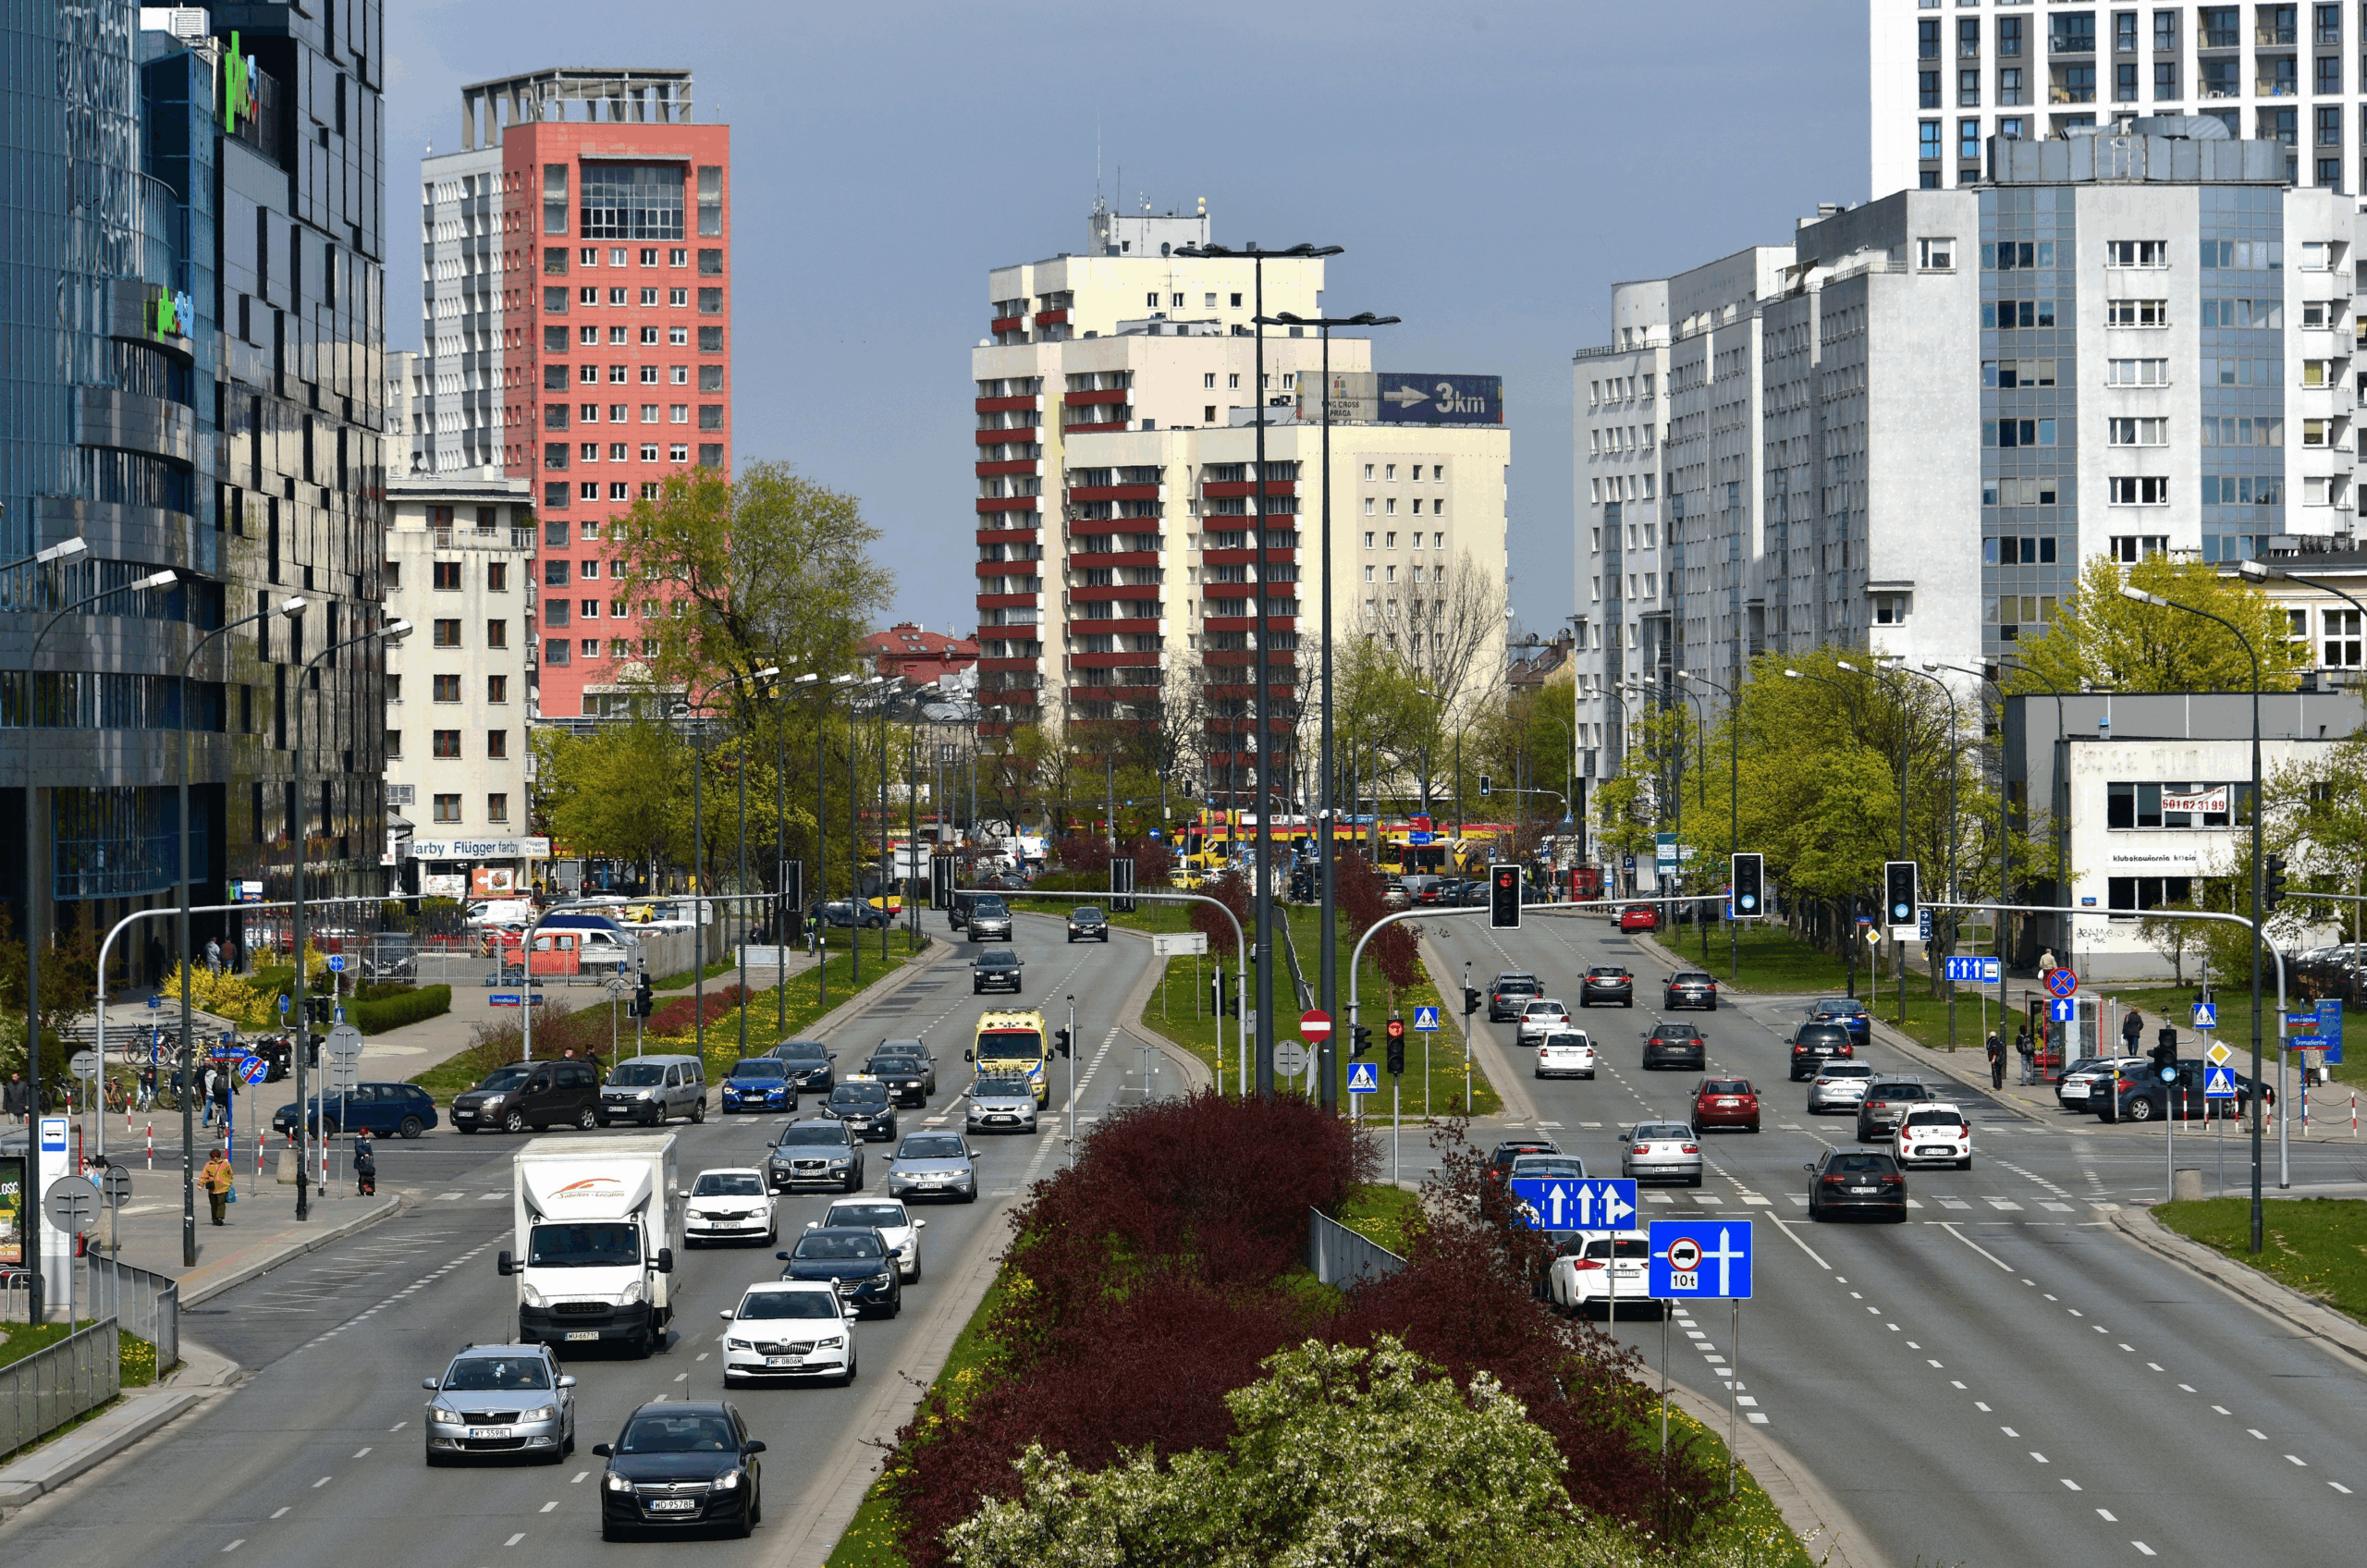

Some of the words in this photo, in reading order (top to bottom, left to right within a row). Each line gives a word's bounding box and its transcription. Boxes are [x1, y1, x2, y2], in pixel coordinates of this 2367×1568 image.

[1338, 400, 1360, 409] CROSS
[2162, 799, 2180, 809] 601
[2183, 800, 2195, 810] 62
[2198, 800, 2209, 810] 31
[2212, 800, 2225, 811] 99
[412, 841, 445, 856] arby
[453, 841, 496, 855] Flügger
[498, 840, 520, 855] farby
[0, 1181, 18, 1195] OŚĆ
[486, 1428, 508, 1437] 5598L
[655, 1501, 667, 1509] WD
[668, 1500, 693, 1508] 9578E
